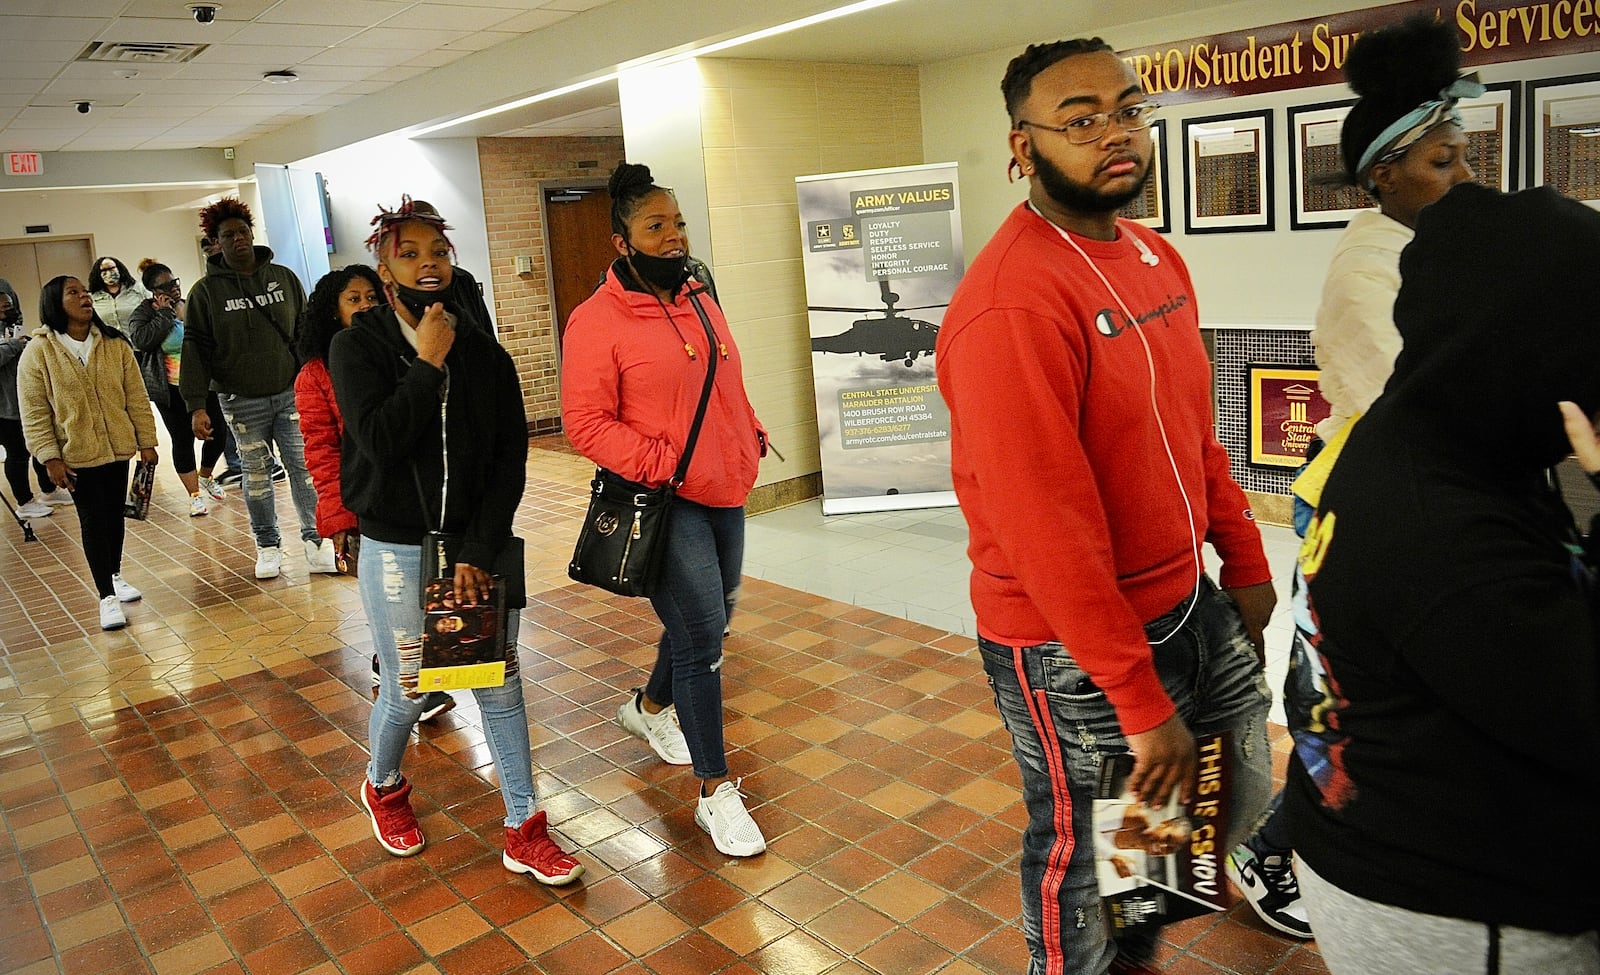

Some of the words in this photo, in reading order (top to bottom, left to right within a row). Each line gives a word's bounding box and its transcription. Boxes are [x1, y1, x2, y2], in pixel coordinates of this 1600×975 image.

[10, 153, 37, 173] EXIT
[855, 193, 895, 208] ARMY
[898, 188, 950, 204] VALUES
[868, 221, 901, 231] LOYALTY
[869, 230, 890, 238] DUTY
[869, 236, 903, 246] RESPECT
[870, 243, 907, 253] SELFLESS
[908, 240, 941, 250] SERVICE
[871, 252, 898, 261] HONOR
[871, 259, 911, 269] INTEGRITY
[872, 267, 913, 277] PERSONAL
[913, 263, 949, 273] COURAGE
[1095, 293, 1187, 338] Champion
[841, 391, 875, 400] CENTRAL
[876, 387, 899, 397] STATE
[842, 398, 883, 409] MARAUDER
[884, 394, 924, 405] BATTALION
[843, 409, 861, 418] 1400
[861, 406, 887, 417] BRUSH
[887, 405, 906, 414] ROW
[905, 403, 926, 413] ROAD
[844, 415, 897, 427] WILBERFORCE,
[896, 414, 908, 423] OH
[908, 412, 933, 421] 45384
[1280, 420, 1317, 434] Central
[845, 430, 947, 445] armyrotc.com/edu/centralstate
[1286, 431, 1311, 444] State
[1197, 736, 1222, 796] THIS
[1193, 799, 1220, 817] IS
